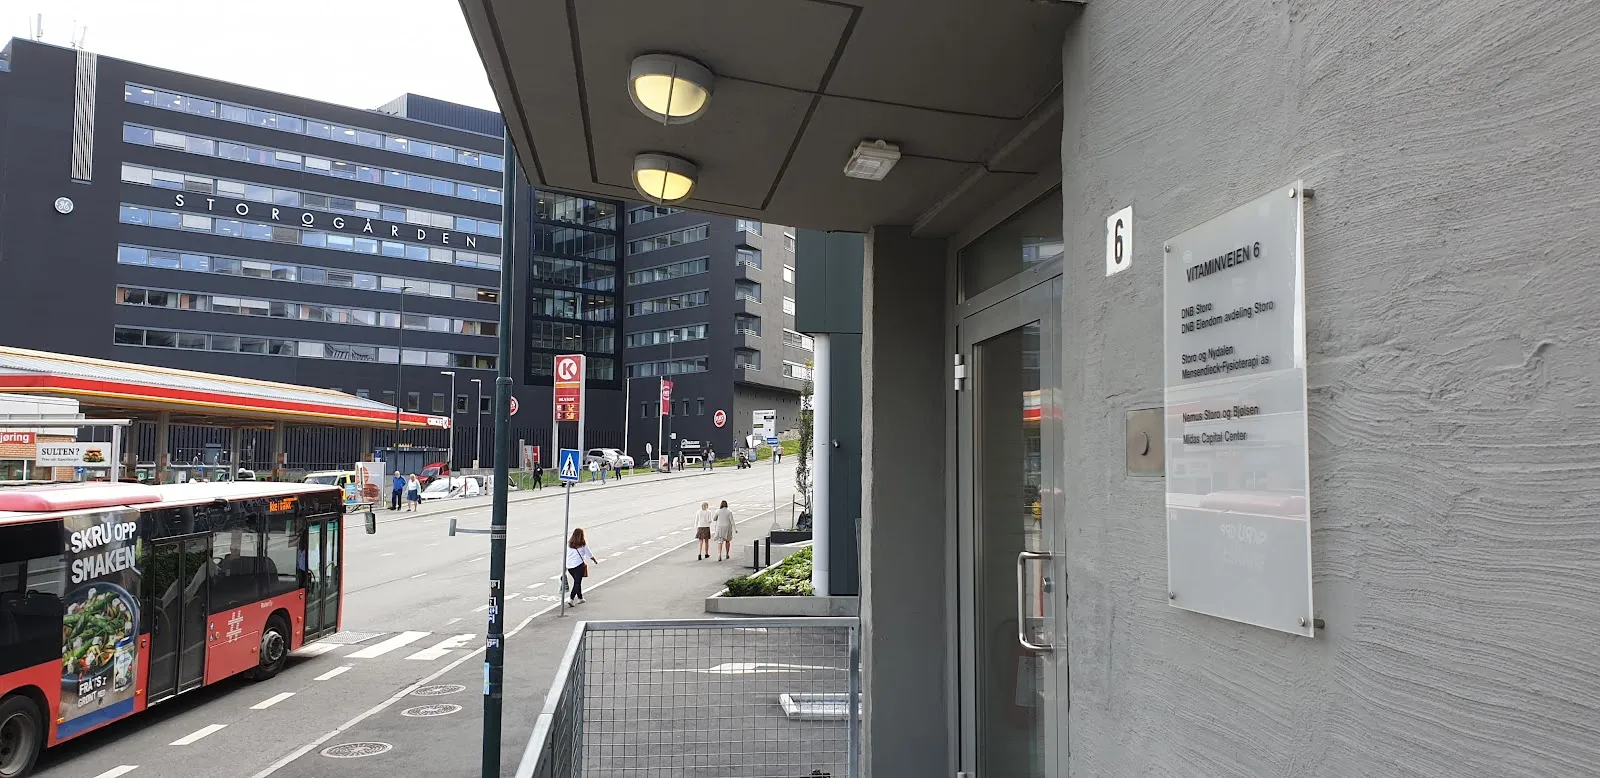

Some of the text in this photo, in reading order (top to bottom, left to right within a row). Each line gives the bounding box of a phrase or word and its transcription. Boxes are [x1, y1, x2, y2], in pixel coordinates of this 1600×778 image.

[175, 194, 477, 248] STOROGÅRDEN
[1114, 218, 1124, 265] 6
[1186, 241, 1260, 282] VITAMINVEIEN 6
[1181, 302, 1212, 319] DNB Storo
[1181, 301, 1274, 334] DNB Eiendom avdeling Storo
[1181, 345, 1234, 365] Storo og Nydalen
[1181, 354, 1270, 380] Mensendieck-Fysioterapi as
[562, 362, 575, 377] K
[1182, 405, 1260, 423] Nemus Storo og Bjølsen
[1183, 431, 1248, 445] Midas Capital Center
[41, 447, 80, 456] SULTEN?
[70, 521, 137, 553] SKRU OPP
[71, 544, 136, 584] SMAKEN
